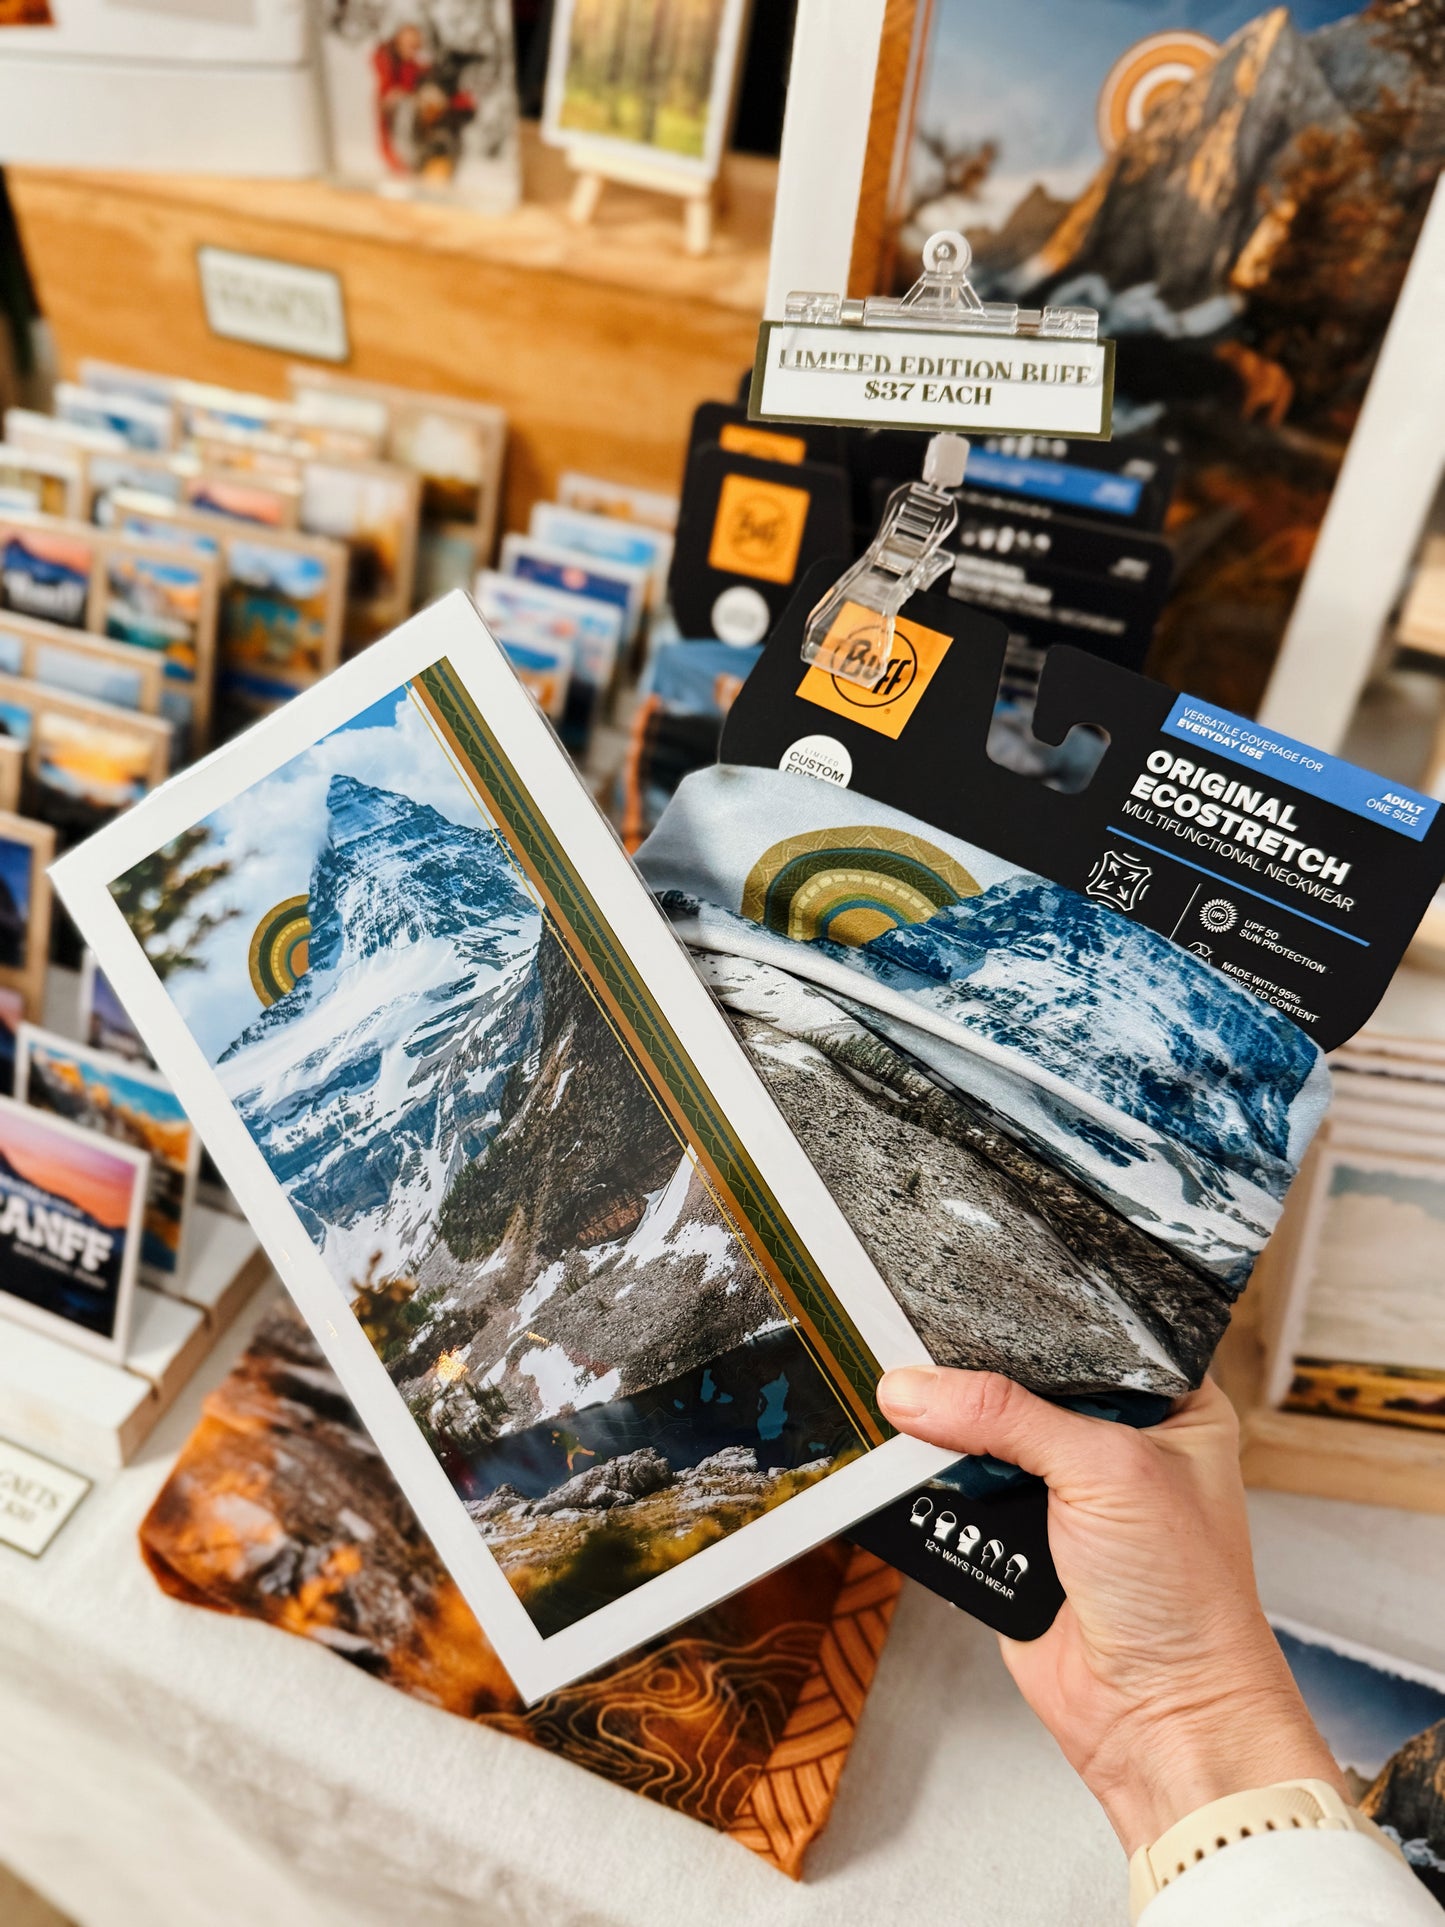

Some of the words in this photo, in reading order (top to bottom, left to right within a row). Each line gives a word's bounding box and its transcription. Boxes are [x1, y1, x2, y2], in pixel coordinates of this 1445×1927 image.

[778, 350, 891, 373] LIMITED
[900, 355, 1013, 380] EDITION
[1021, 363, 1093, 384] BUFF
[864, 380, 915, 401] $37
[921, 384, 992, 406] EACH
[805, 748, 839, 767] LIMITED
[1177, 719, 1240, 753] EVERYDAY
[1239, 744, 1265, 761] USE
[1183, 707, 1240, 737] VERSATILE
[1239, 731, 1298, 762] COVERAGE
[1299, 757, 1324, 773] FOR
[790, 751, 844, 782] CUSTOM
[1146, 750, 1299, 832] ORIGINAL
[1382, 792, 1426, 815] ADULT
[1130, 774, 1352, 886] ECOSTRETCH
[1366, 798, 1392, 815] ONE
[1392, 810, 1420, 827] SIZE
[1121, 800, 1261, 872] MULTIFUNCTIONAL
[1263, 863, 1355, 912] NECKWEAR
[1211, 910, 1225, 921] UPF
[1244, 919, 1265, 933] UPF
[1264, 930, 1279, 940] 50
[1239, 929, 1263, 944] SUN
[1261, 940, 1326, 974] PROTECTION
[1221, 961, 1253, 981] MADE
[1252, 975, 1279, 993] WITH
[1277, 988, 1302, 1004] 95%
[1269, 996, 1321, 1024] CONTENT
[0, 1193, 114, 1273] ANFF
[924, 1538, 941, 1554] 12+
[942, 1548, 970, 1571] WAYS
[969, 1565, 984, 1580] TO
[985, 1574, 1015, 1600] WEAR
